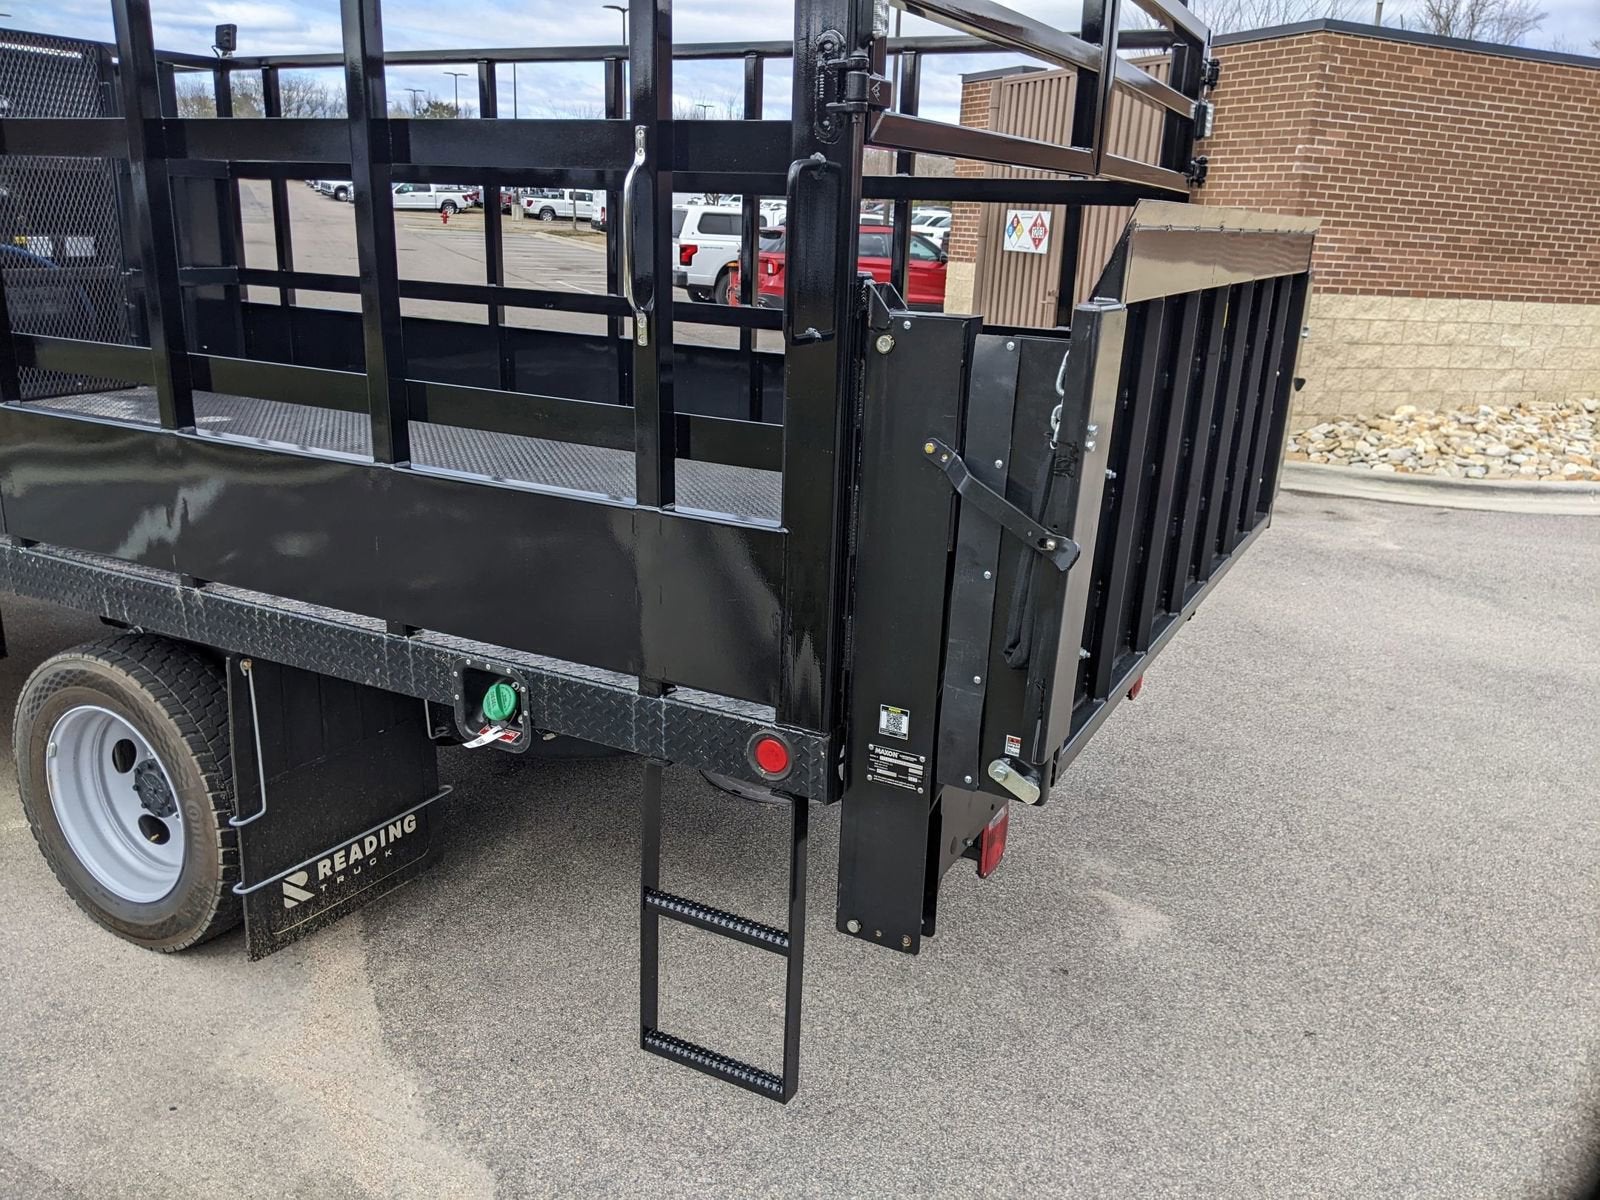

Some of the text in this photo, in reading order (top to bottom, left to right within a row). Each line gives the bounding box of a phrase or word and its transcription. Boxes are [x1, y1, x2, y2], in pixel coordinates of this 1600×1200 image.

[874, 747, 900, 758] MAXON
[317, 814, 417, 880] READING
[320, 849, 392, 892] TRUCK
